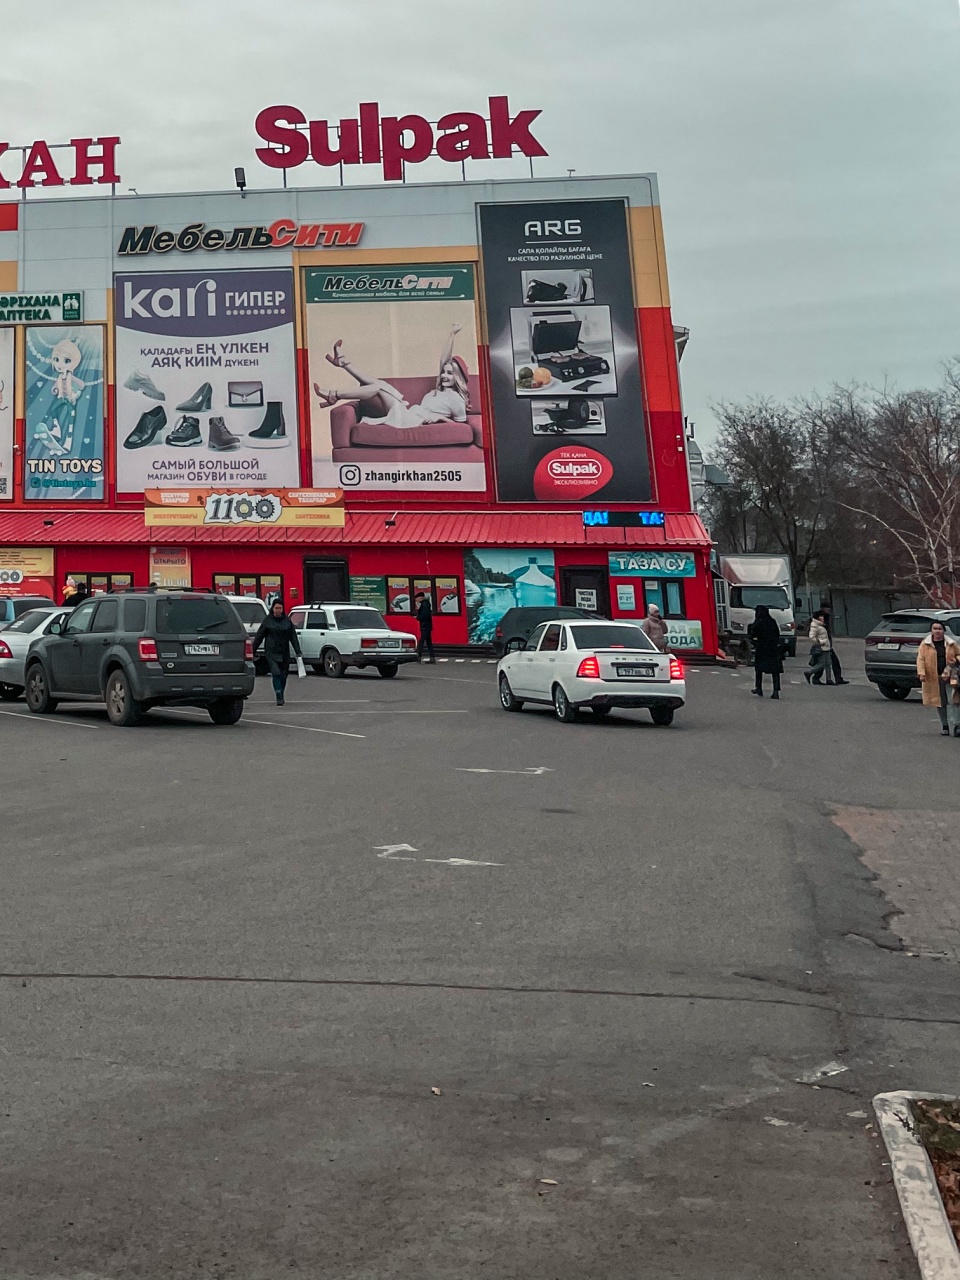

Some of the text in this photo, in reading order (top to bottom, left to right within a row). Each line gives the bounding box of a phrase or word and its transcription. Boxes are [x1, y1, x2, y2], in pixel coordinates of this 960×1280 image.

[255, 96, 549, 181] Sulpak
[524, 219, 582, 236] ARG
[118, 219, 365, 255] МебельСити
[550, 253, 586, 261] РАЗУМНОЙ
[322, 274, 454, 292] МебельСити
[123, 279, 217, 319] kari
[224, 290, 286, 308] ГИПЕР
[140, 342, 269, 356] ҚАЛАДАҒЫ ЕҢ ҮЛКЕН
[151, 356, 259, 369] АЯҚ КИІМ ДҮКЕНІ
[27, 458, 103, 474] TIN TOYS
[152, 458, 259, 470] САМЫЙ БОЛЬШОЙ
[551, 462, 598, 477] Sulpak
[187, 471, 227, 481] ОБУВИ
[235, 473, 268, 481] ГОРОДЕ
[364, 469, 462, 484] zhangirkhan2505
[616, 557, 687, 571] ТАЗА СУ
